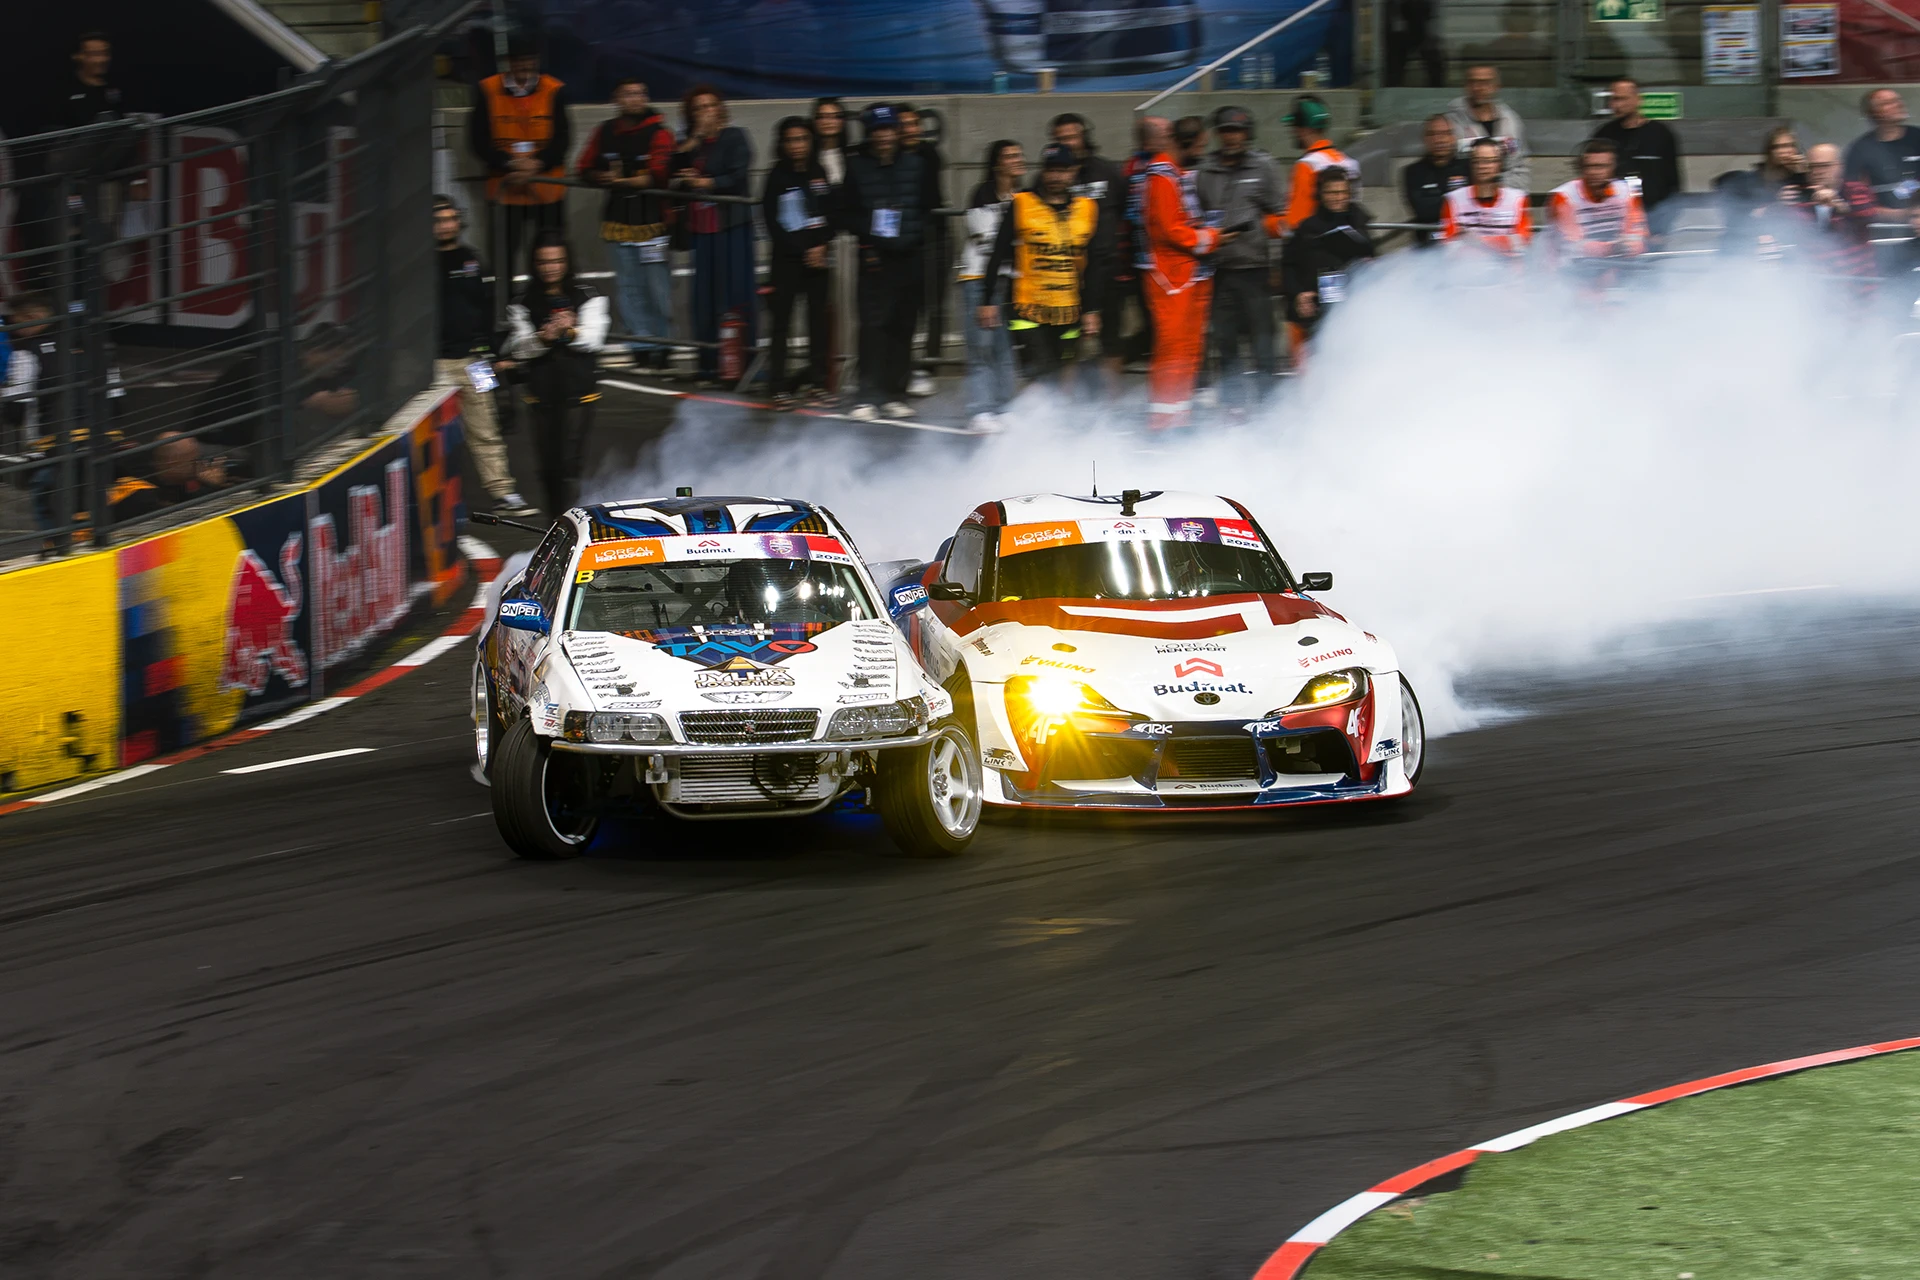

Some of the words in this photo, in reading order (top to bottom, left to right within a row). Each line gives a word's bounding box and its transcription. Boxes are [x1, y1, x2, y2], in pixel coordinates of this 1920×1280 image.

[1219, 526, 1256, 538] 215
[1226, 538, 1260, 549] 2026
[686, 547, 736, 556] Budmat.
[815, 553, 850, 562] 2026
[575, 570, 595, 584] B
[652, 640, 818, 657] TAVO
[1311, 647, 1353, 663] VALINO
[1037, 659, 1097, 674] VALINO
[696, 680, 796, 688] LOGISTICS
